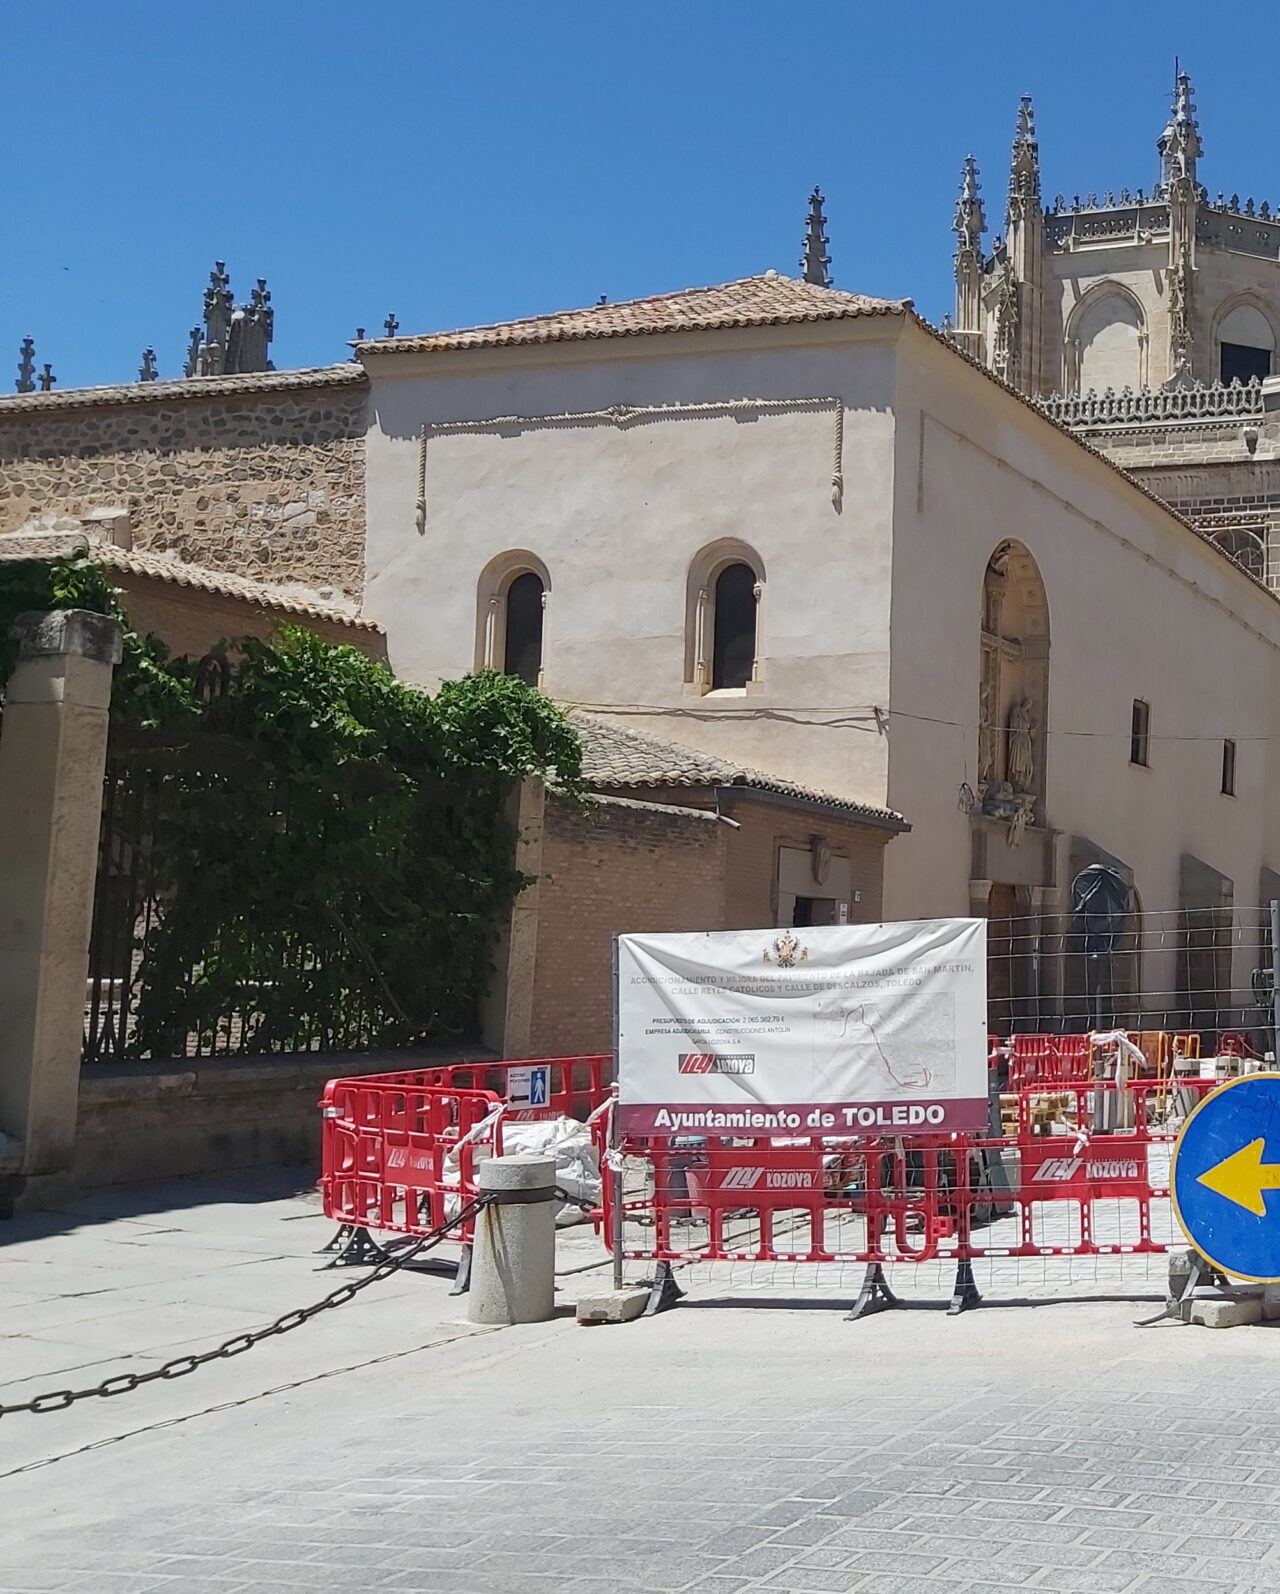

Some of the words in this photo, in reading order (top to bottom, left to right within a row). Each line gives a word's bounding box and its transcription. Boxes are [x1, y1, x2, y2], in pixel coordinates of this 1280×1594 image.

[760, 975, 775, 983] DEL
[777, 973, 827, 982] PAVIMENTO
[829, 972, 841, 980] DE
[858, 969, 894, 977] BAJADA
[896, 967, 909, 975] DE
[912, 966, 930, 975] SAN
[671, 986, 699, 995] CALLE
[700, 986, 728, 994] REYES
[785, 984, 811, 992] CALLE
[813, 983, 824, 991] DE
[886, 979, 921, 987] TOLEDO
[654, 1109, 800, 1131] Ayuntamiento
[807, 1109, 835, 1127] de
[842, 1105, 945, 1126] TOLEDO
